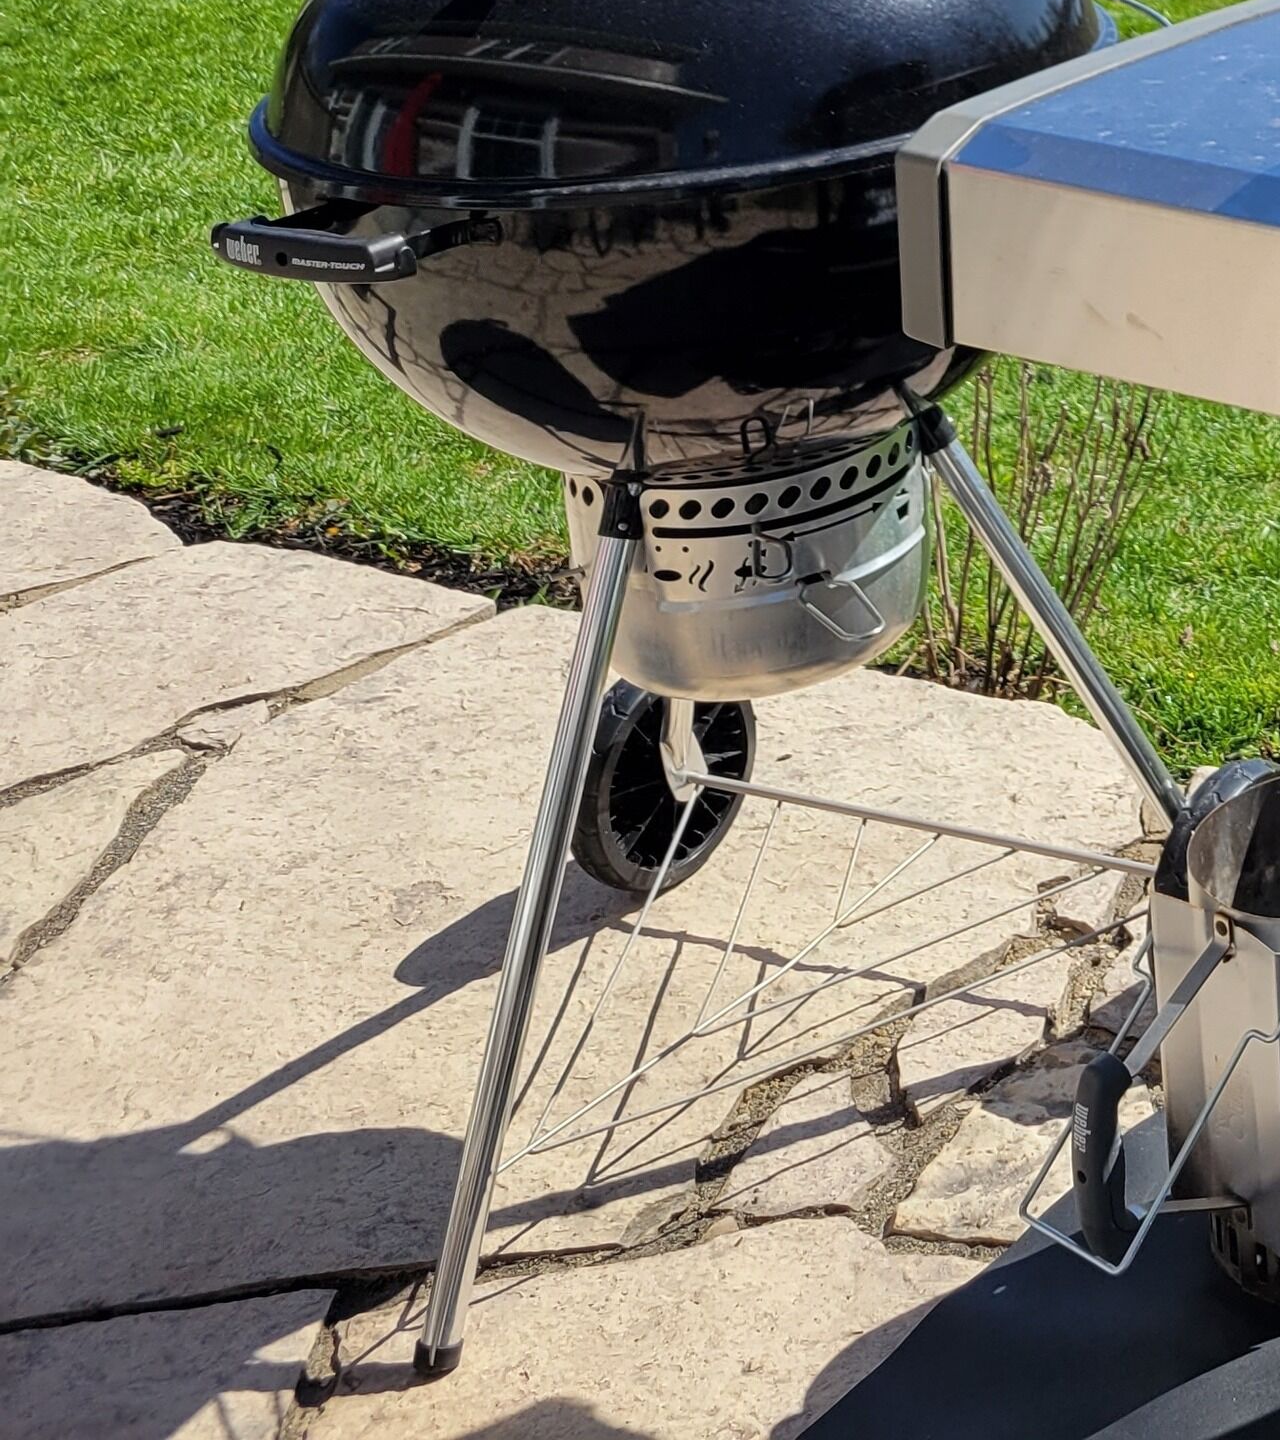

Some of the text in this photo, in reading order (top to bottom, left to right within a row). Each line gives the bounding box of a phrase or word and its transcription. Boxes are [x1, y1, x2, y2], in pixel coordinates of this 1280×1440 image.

[226, 235, 260, 265] weber
[291, 257, 366, 271] MASTER-TOUCH
[1073, 1102, 1092, 1153] weber
